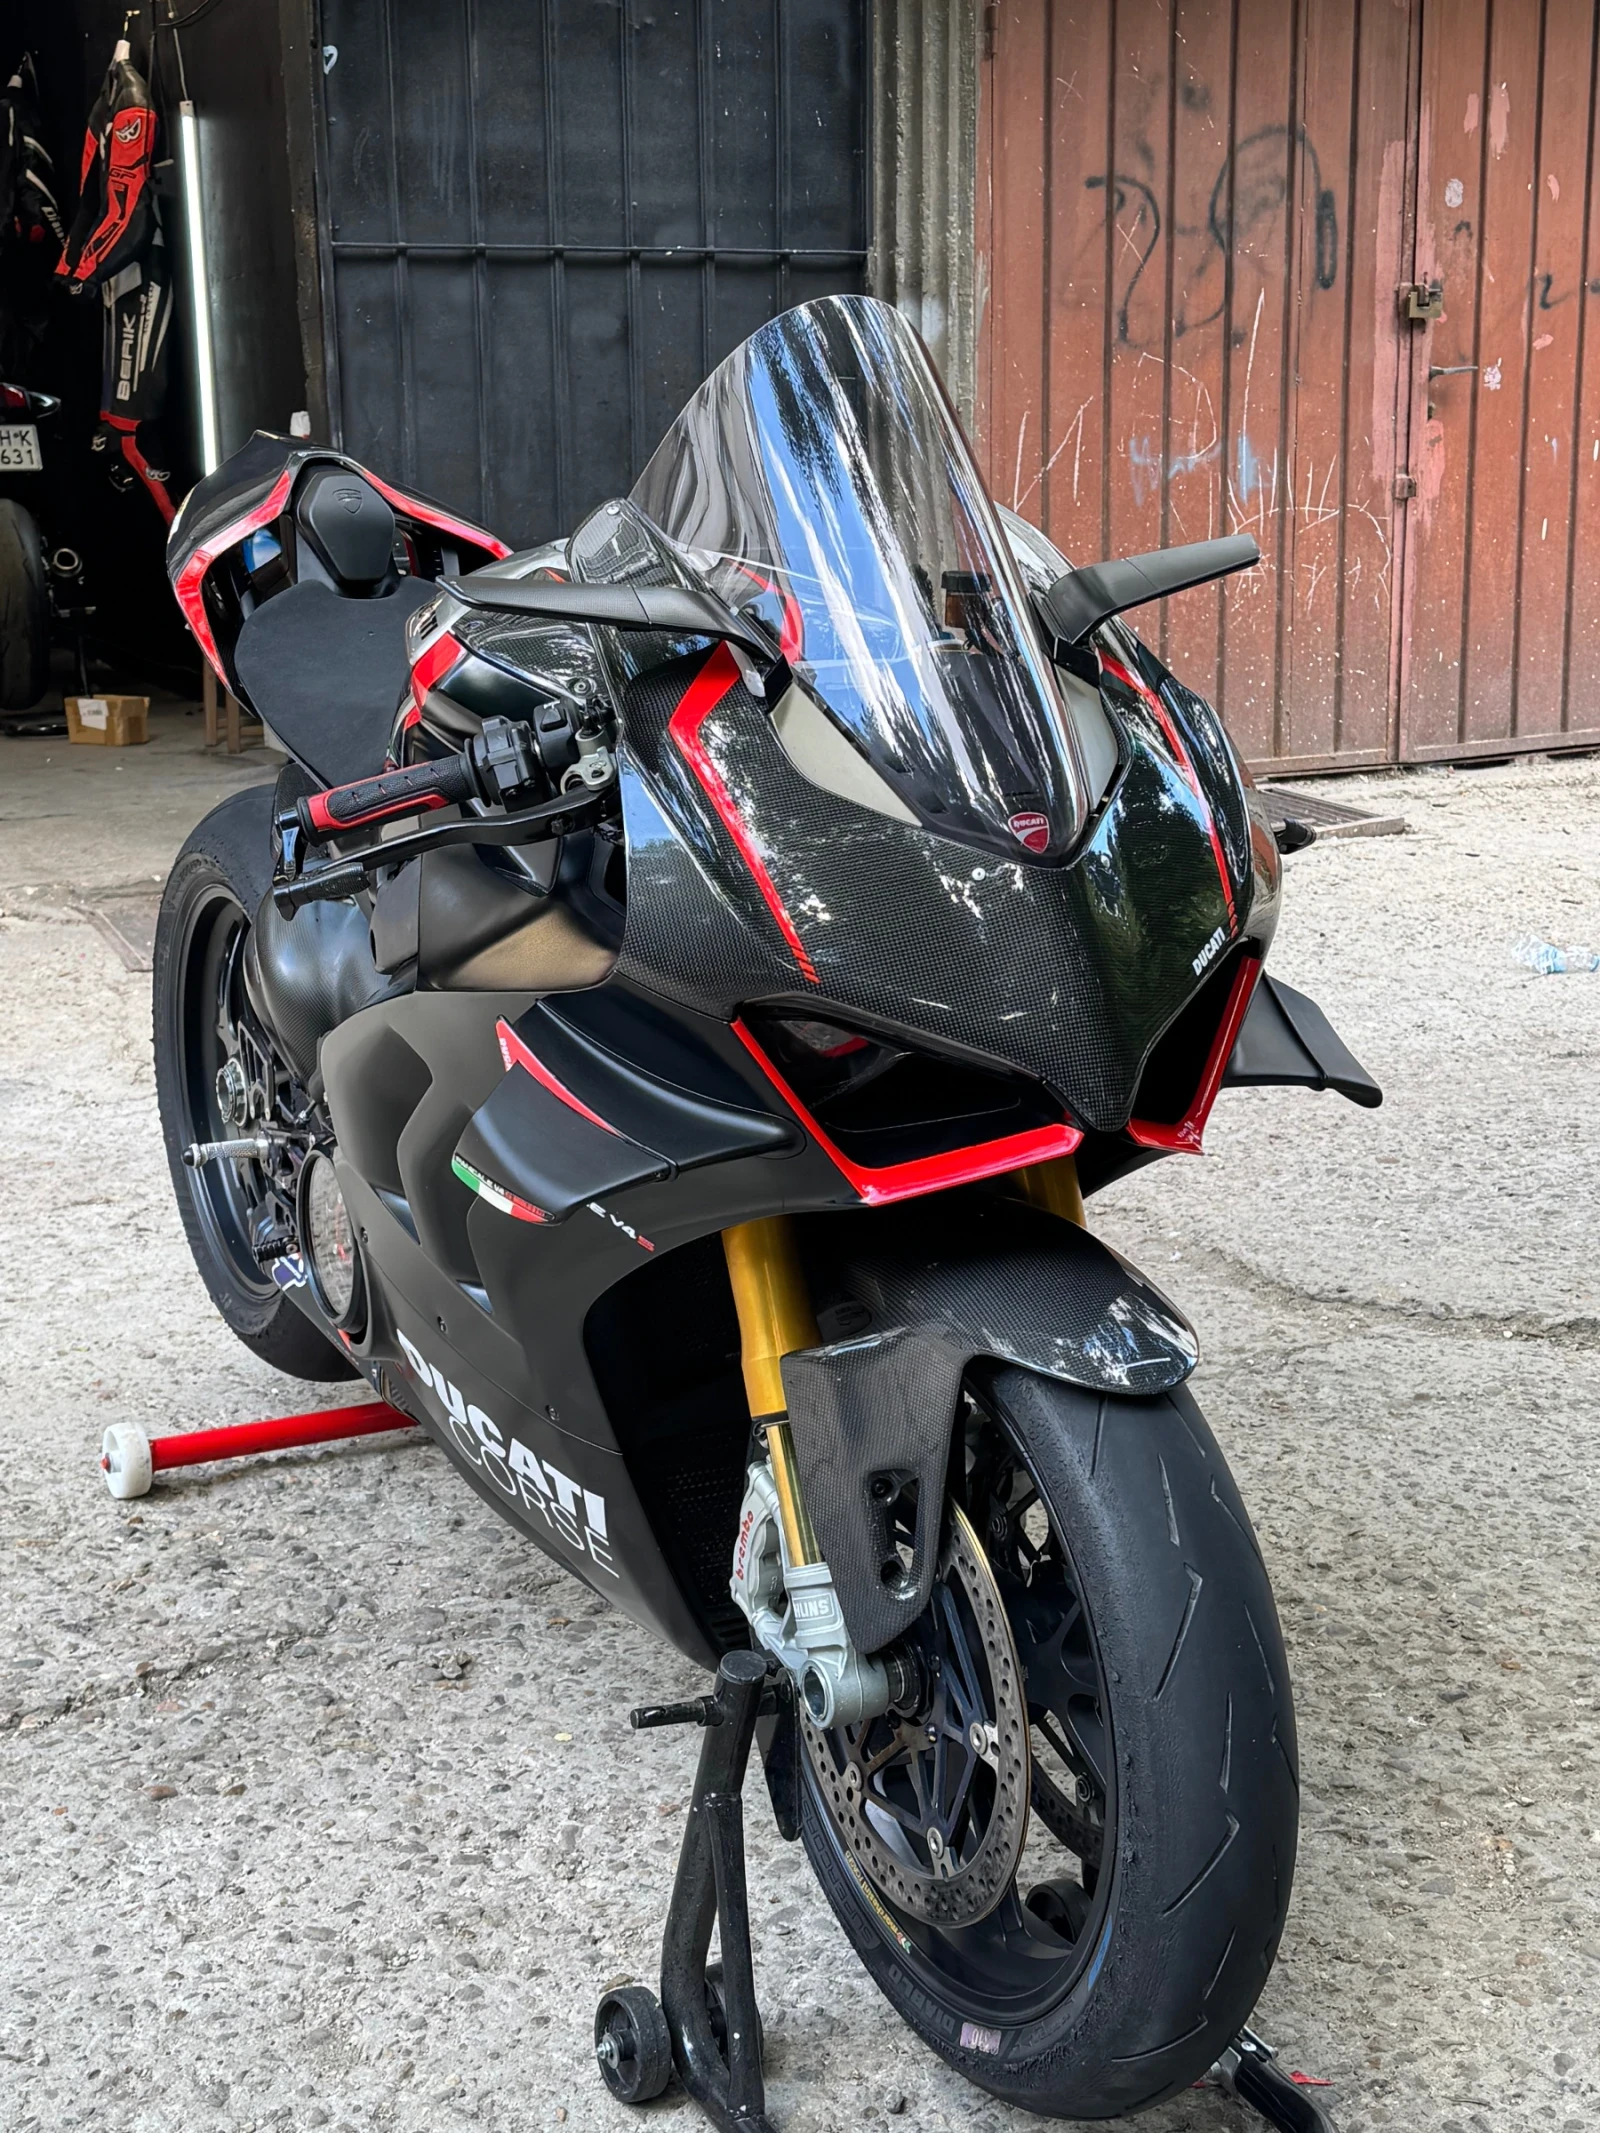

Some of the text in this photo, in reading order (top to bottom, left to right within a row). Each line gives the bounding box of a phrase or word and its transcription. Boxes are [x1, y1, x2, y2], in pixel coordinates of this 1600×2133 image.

[116, 312, 137, 401] BERIK
[1013, 817, 1044, 828] DUCATI
[1192, 926, 1226, 976] DUCATI
[396, 1328, 609, 1540] DUCATI
[449, 1415, 620, 1579] CORSE
[735, 1510, 754, 1581] brembo
[801, 1799, 875, 1945] SUPERCORS
[888, 1963, 956, 2035] DIABLO
